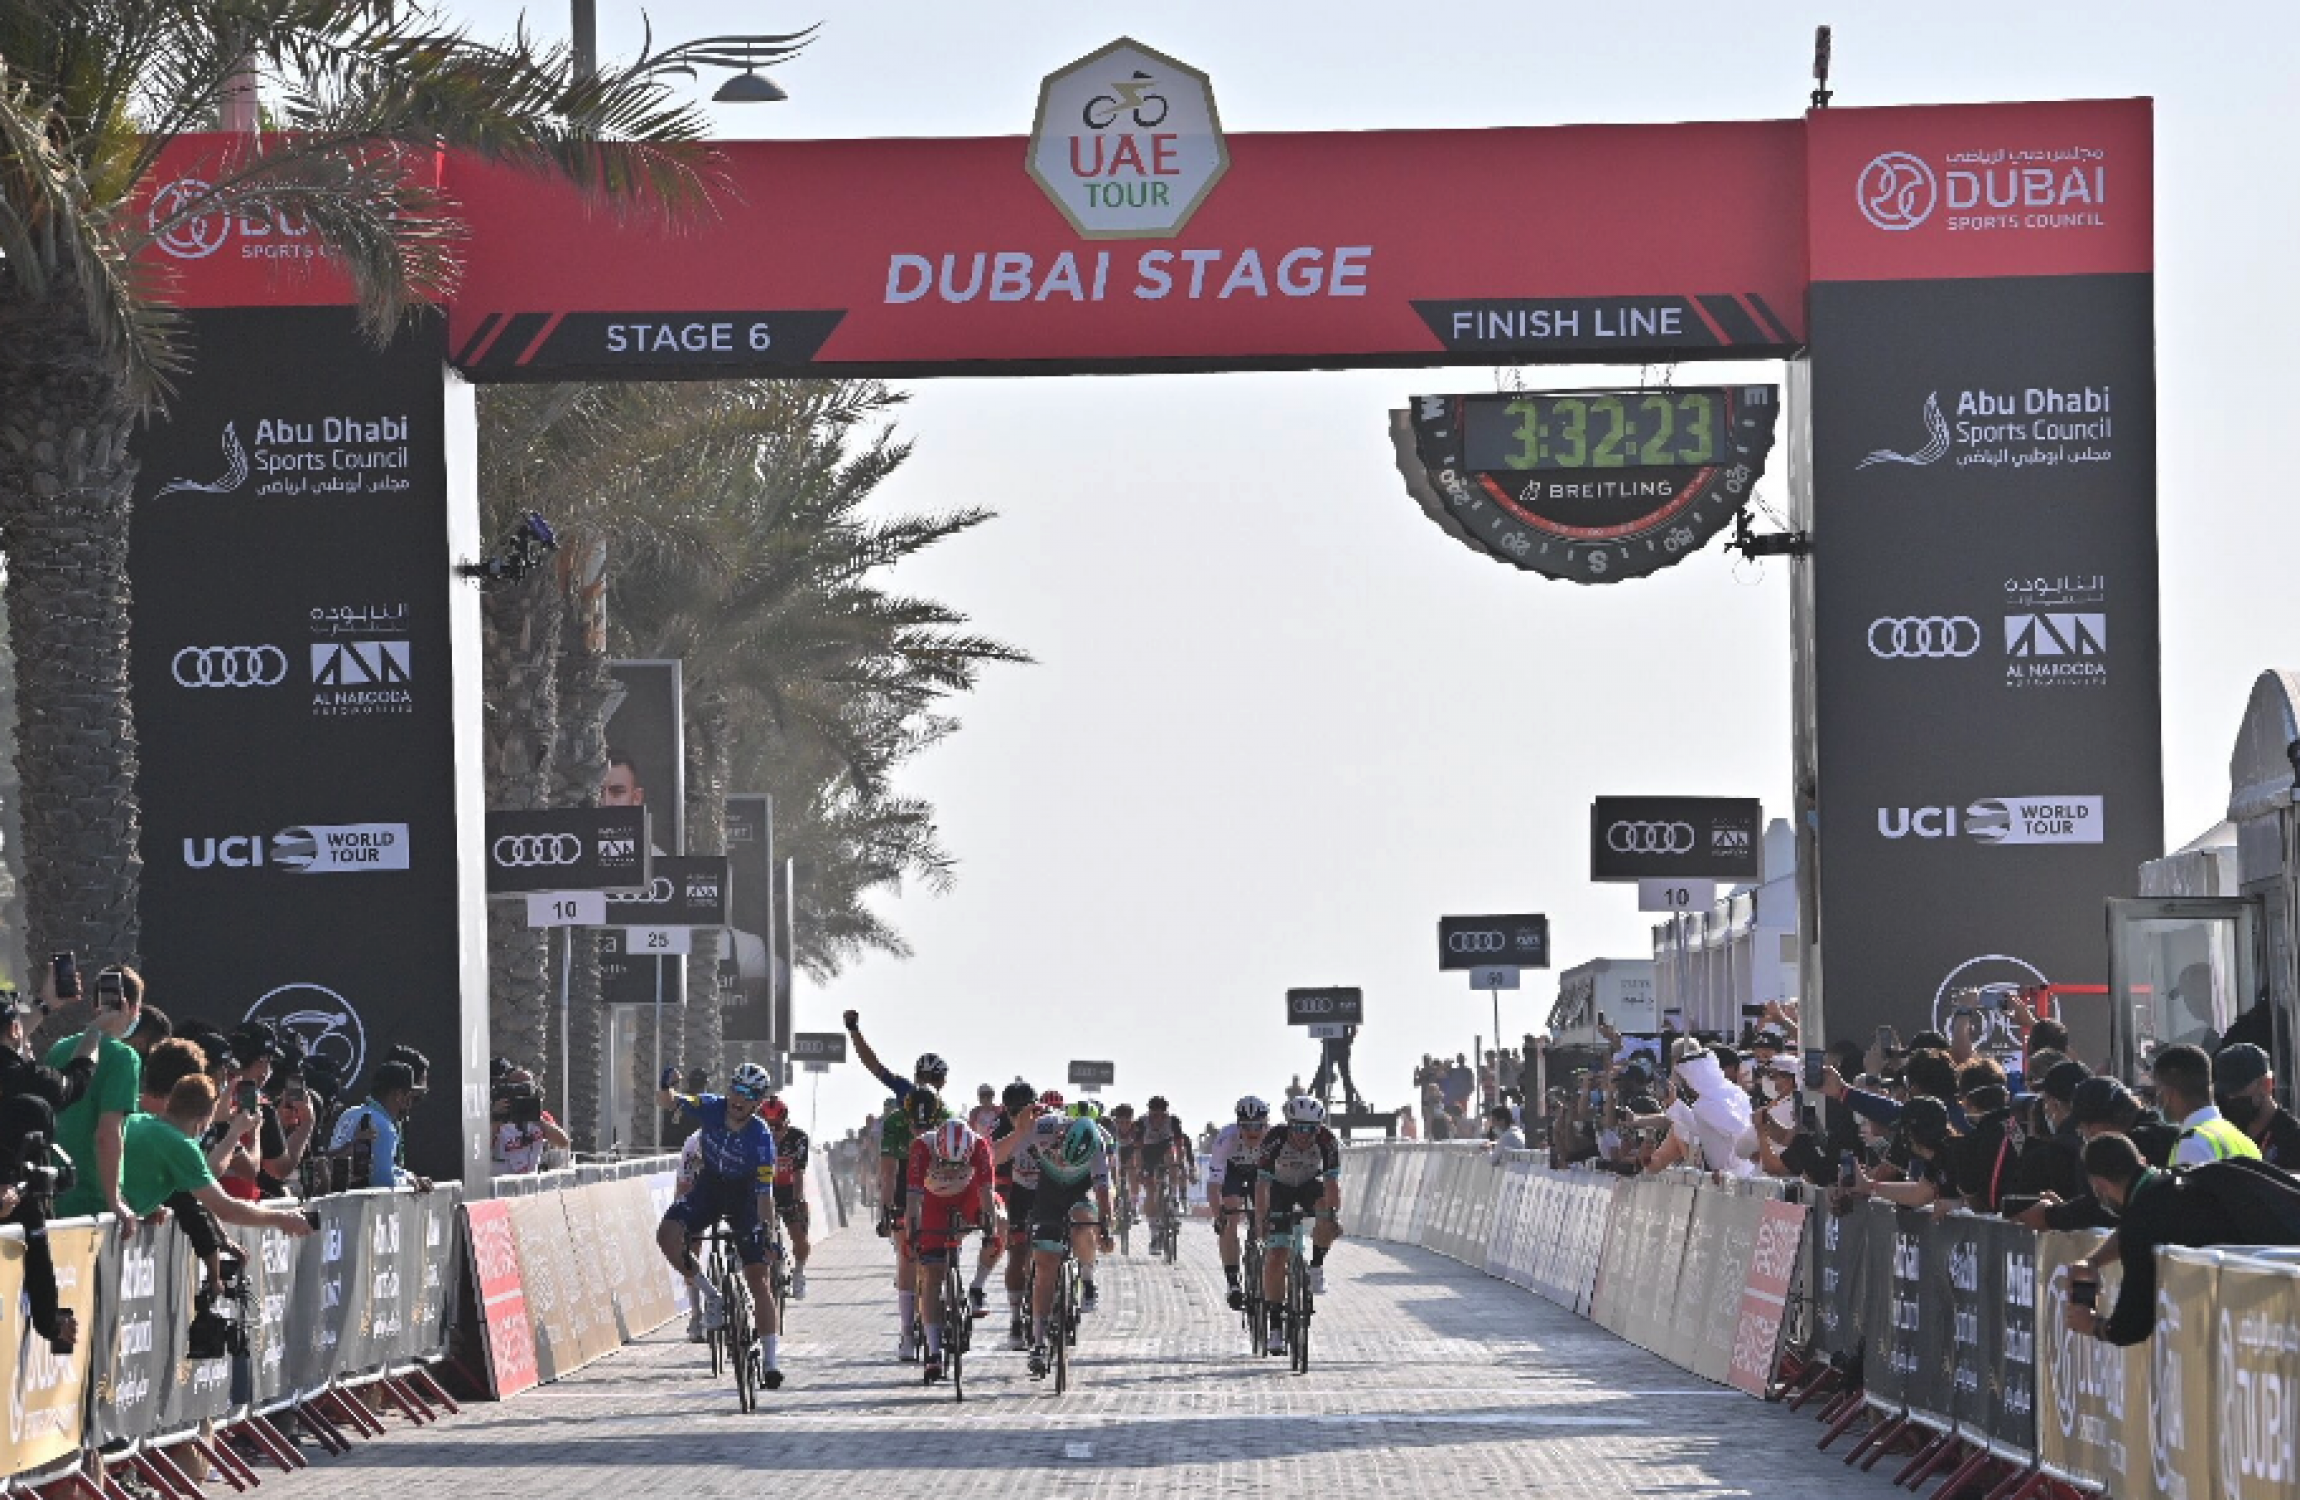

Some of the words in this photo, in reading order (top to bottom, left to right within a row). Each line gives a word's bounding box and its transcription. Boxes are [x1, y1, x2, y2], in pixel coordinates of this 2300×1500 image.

[1068, 133, 1180, 177] UAE
[1083, 181, 1170, 207] TOUR
[1946, 166, 2105, 208] DUBAI
[1946, 214, 2020, 231] SPORTS
[2024, 212, 2106, 228] COUNCIL
[884, 250, 1108, 303] DUBAI
[1134, 246, 1372, 299] STAGE
[1452, 310, 1579, 339] FINISH
[1594, 308, 1682, 337] LINE
[606, 323, 734, 352] STAGE
[749, 322, 771, 351] 6
[1956, 388, 2016, 416] Abu
[2024, 386, 2110, 414] Dhabi
[255, 417, 313, 444] Abu
[323, 414, 408, 442] Dhabi
[1504, 394, 1713, 470] 3:32:23
[1956, 421, 2027, 448] Sports
[2032, 417, 2112, 440] Council
[254, 449, 326, 475] Sports
[332, 447, 408, 470] Council
[1550, 481, 1672, 499] BREITLING
[1588, 550, 1609, 574] S
[2006, 664, 2024, 678] AL
[313, 692, 331, 705] AL
[1878, 806, 1958, 838] UCI
[2019, 804, 2089, 819] WORLD
[326, 832, 395, 847] WORLD
[2025, 820, 2074, 834] TOUR
[183, 836, 264, 868] UCI
[330, 848, 380, 862] TOUR
[1664, 888, 1690, 906] 10
[553, 901, 577, 920] 10
[648, 932, 670, 948] 25
